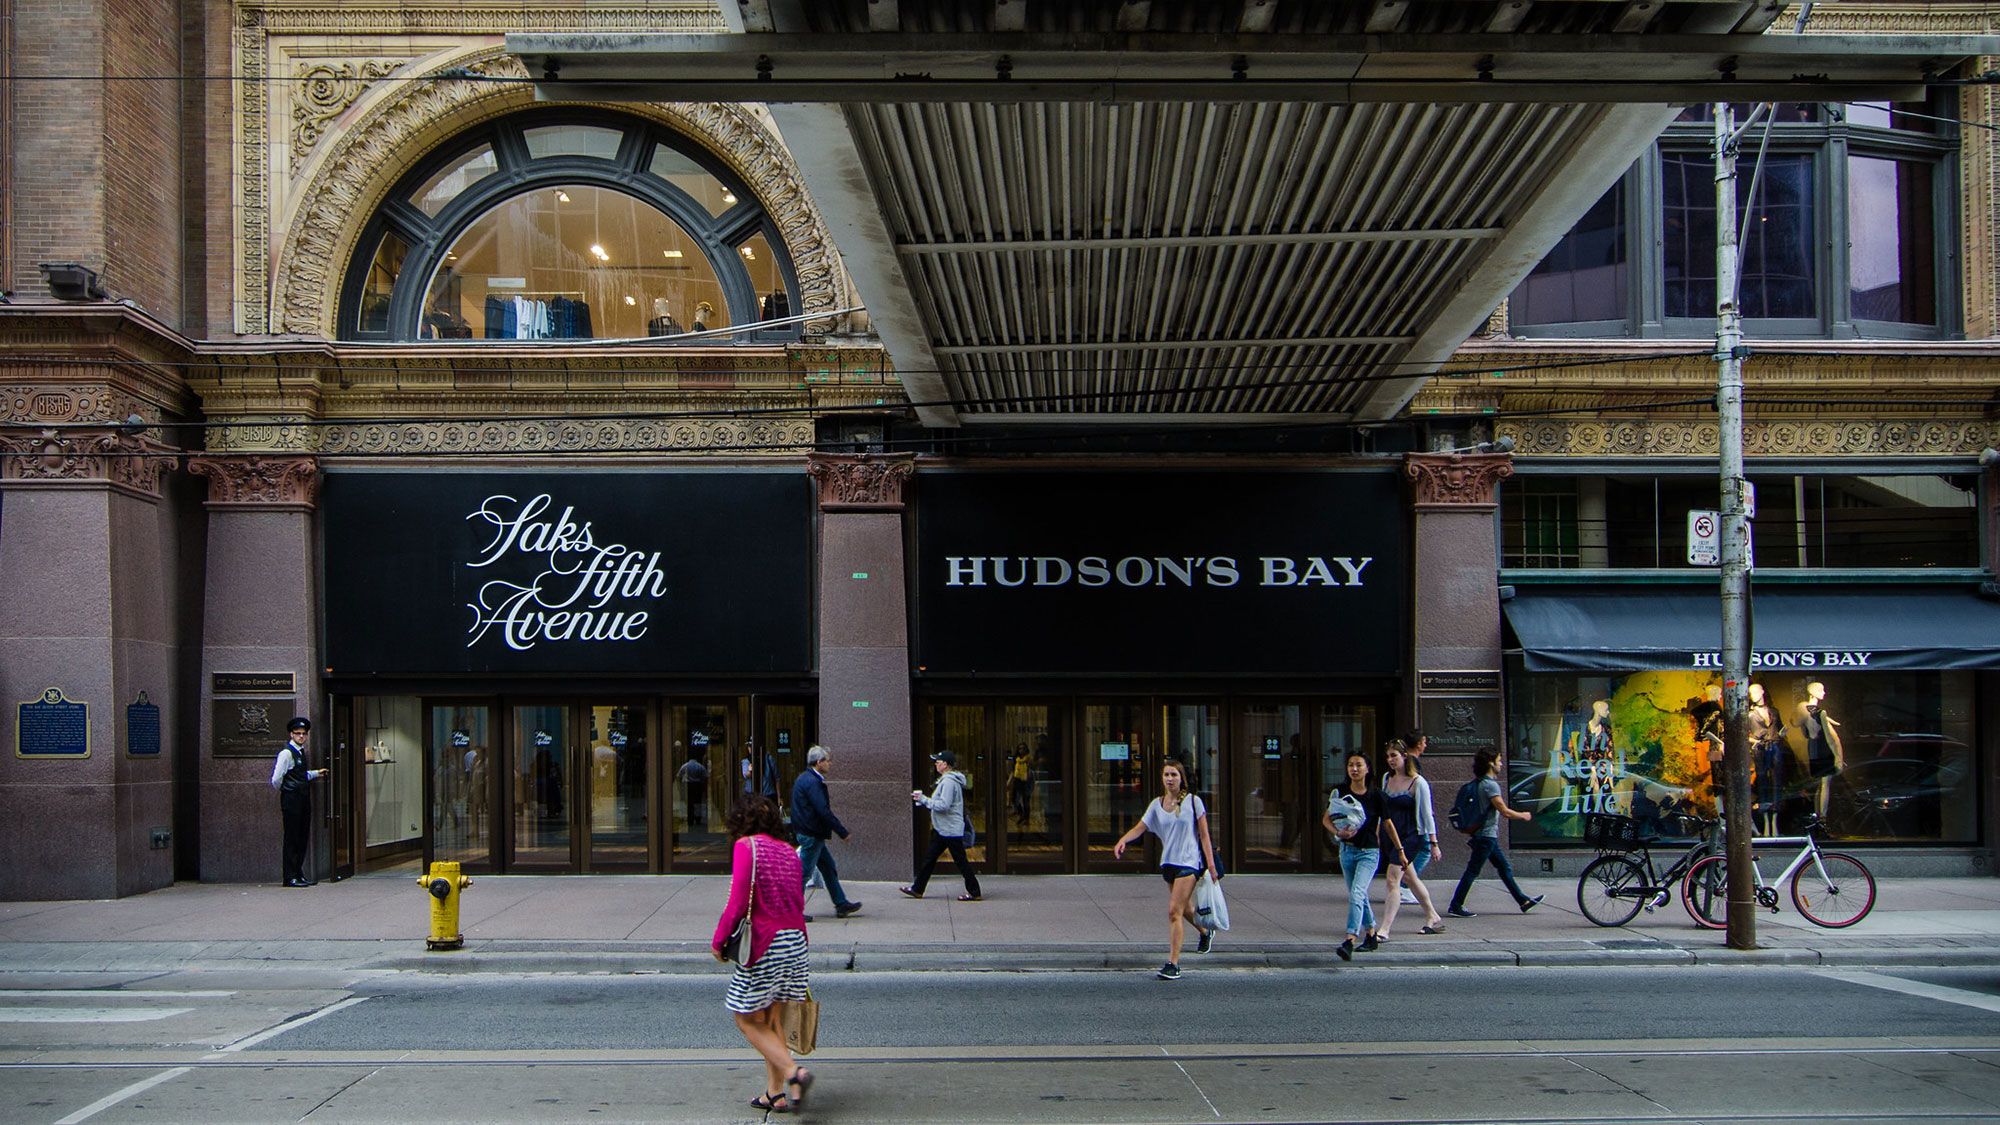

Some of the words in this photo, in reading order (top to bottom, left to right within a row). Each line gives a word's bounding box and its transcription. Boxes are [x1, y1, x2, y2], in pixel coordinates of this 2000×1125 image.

[466, 494, 592, 567] Saks
[945, 556, 1240, 587] HUDSON'S
[1259, 556, 1373, 586] BAY
[466, 580, 649, 650] Avenue
[1692, 652, 1817, 667] HUSON'S
[1823, 652, 1872, 667] BAY
[252, 678, 270, 686] Eaton
[271, 678, 291, 686] Centre
[1576, 722, 1609, 751] In
[1548, 749, 1626, 779] Real
[1558, 783, 1621, 814] Life
